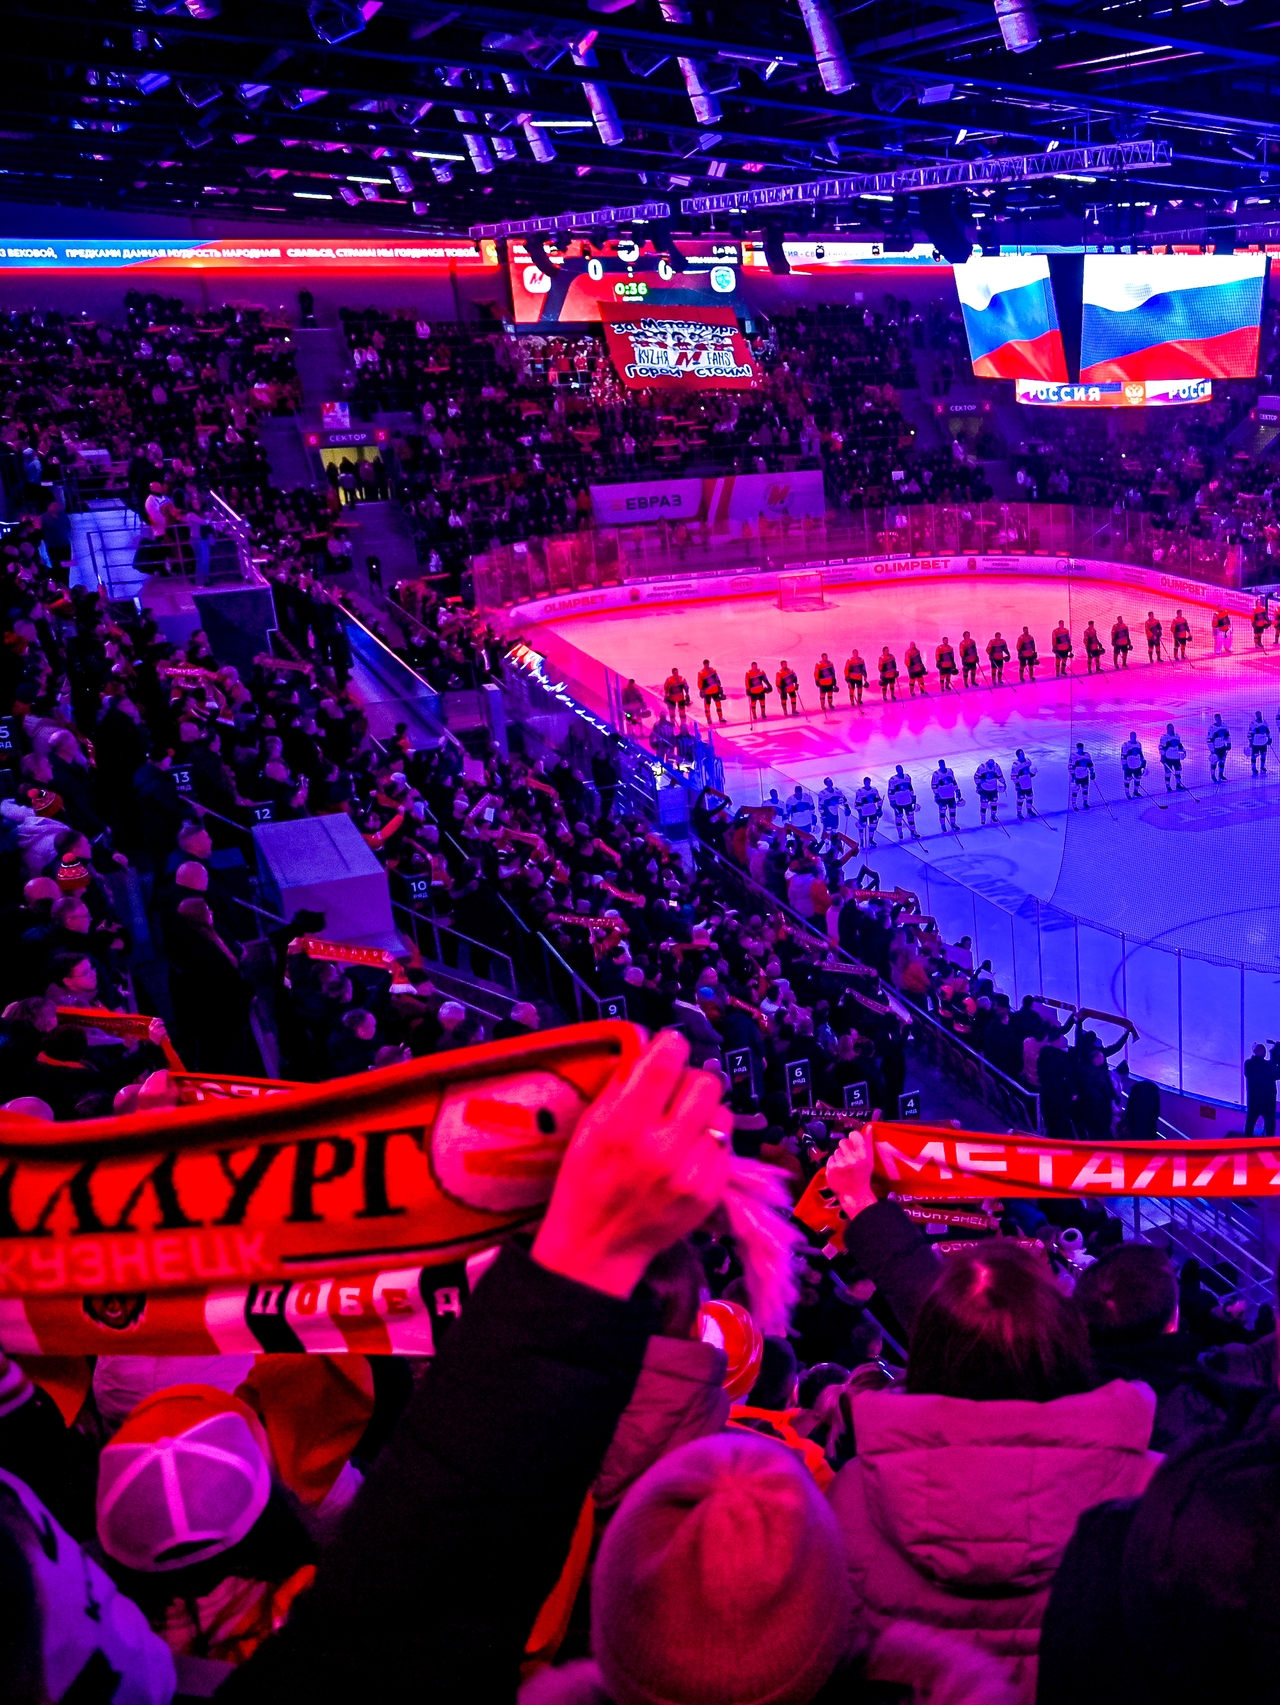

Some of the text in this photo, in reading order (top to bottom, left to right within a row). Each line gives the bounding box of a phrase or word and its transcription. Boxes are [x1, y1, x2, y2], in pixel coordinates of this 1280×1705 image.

[7, 247, 57, 259] ВЕКОВОЙ,
[66, 249, 121, 259] ПРЕДКАМИ
[122, 249, 167, 259] ДАННАЯ
[614, 282, 647, 295] 0:36
[611, 322, 636, 334] За
[706, 351, 731, 366] FANS
[626, 364, 682, 378] Горой
[1029, 386, 1101, 401] РОССИЯ
[950, 404, 977, 412] СЕКТОР
[329, 433, 367, 442] СЕКТОР
[625, 494, 682, 511] ЕВРАЗ
[874, 559, 951, 574] OLIMPBET
[1161, 576, 1207, 597] OLIMPBET
[544, 594, 606, 613] OLIMPBET
[172, 771, 190, 784] 13
[254, 808, 272, 821] 12
[410, 880, 428, 892] 10
[608, 1004, 618, 1015] 9
[735, 1055, 743, 1067] 7
[794, 1067, 803, 1077] 6
[853, 1089, 861, 1100] 5
[907, 1098, 915, 1108] 4
